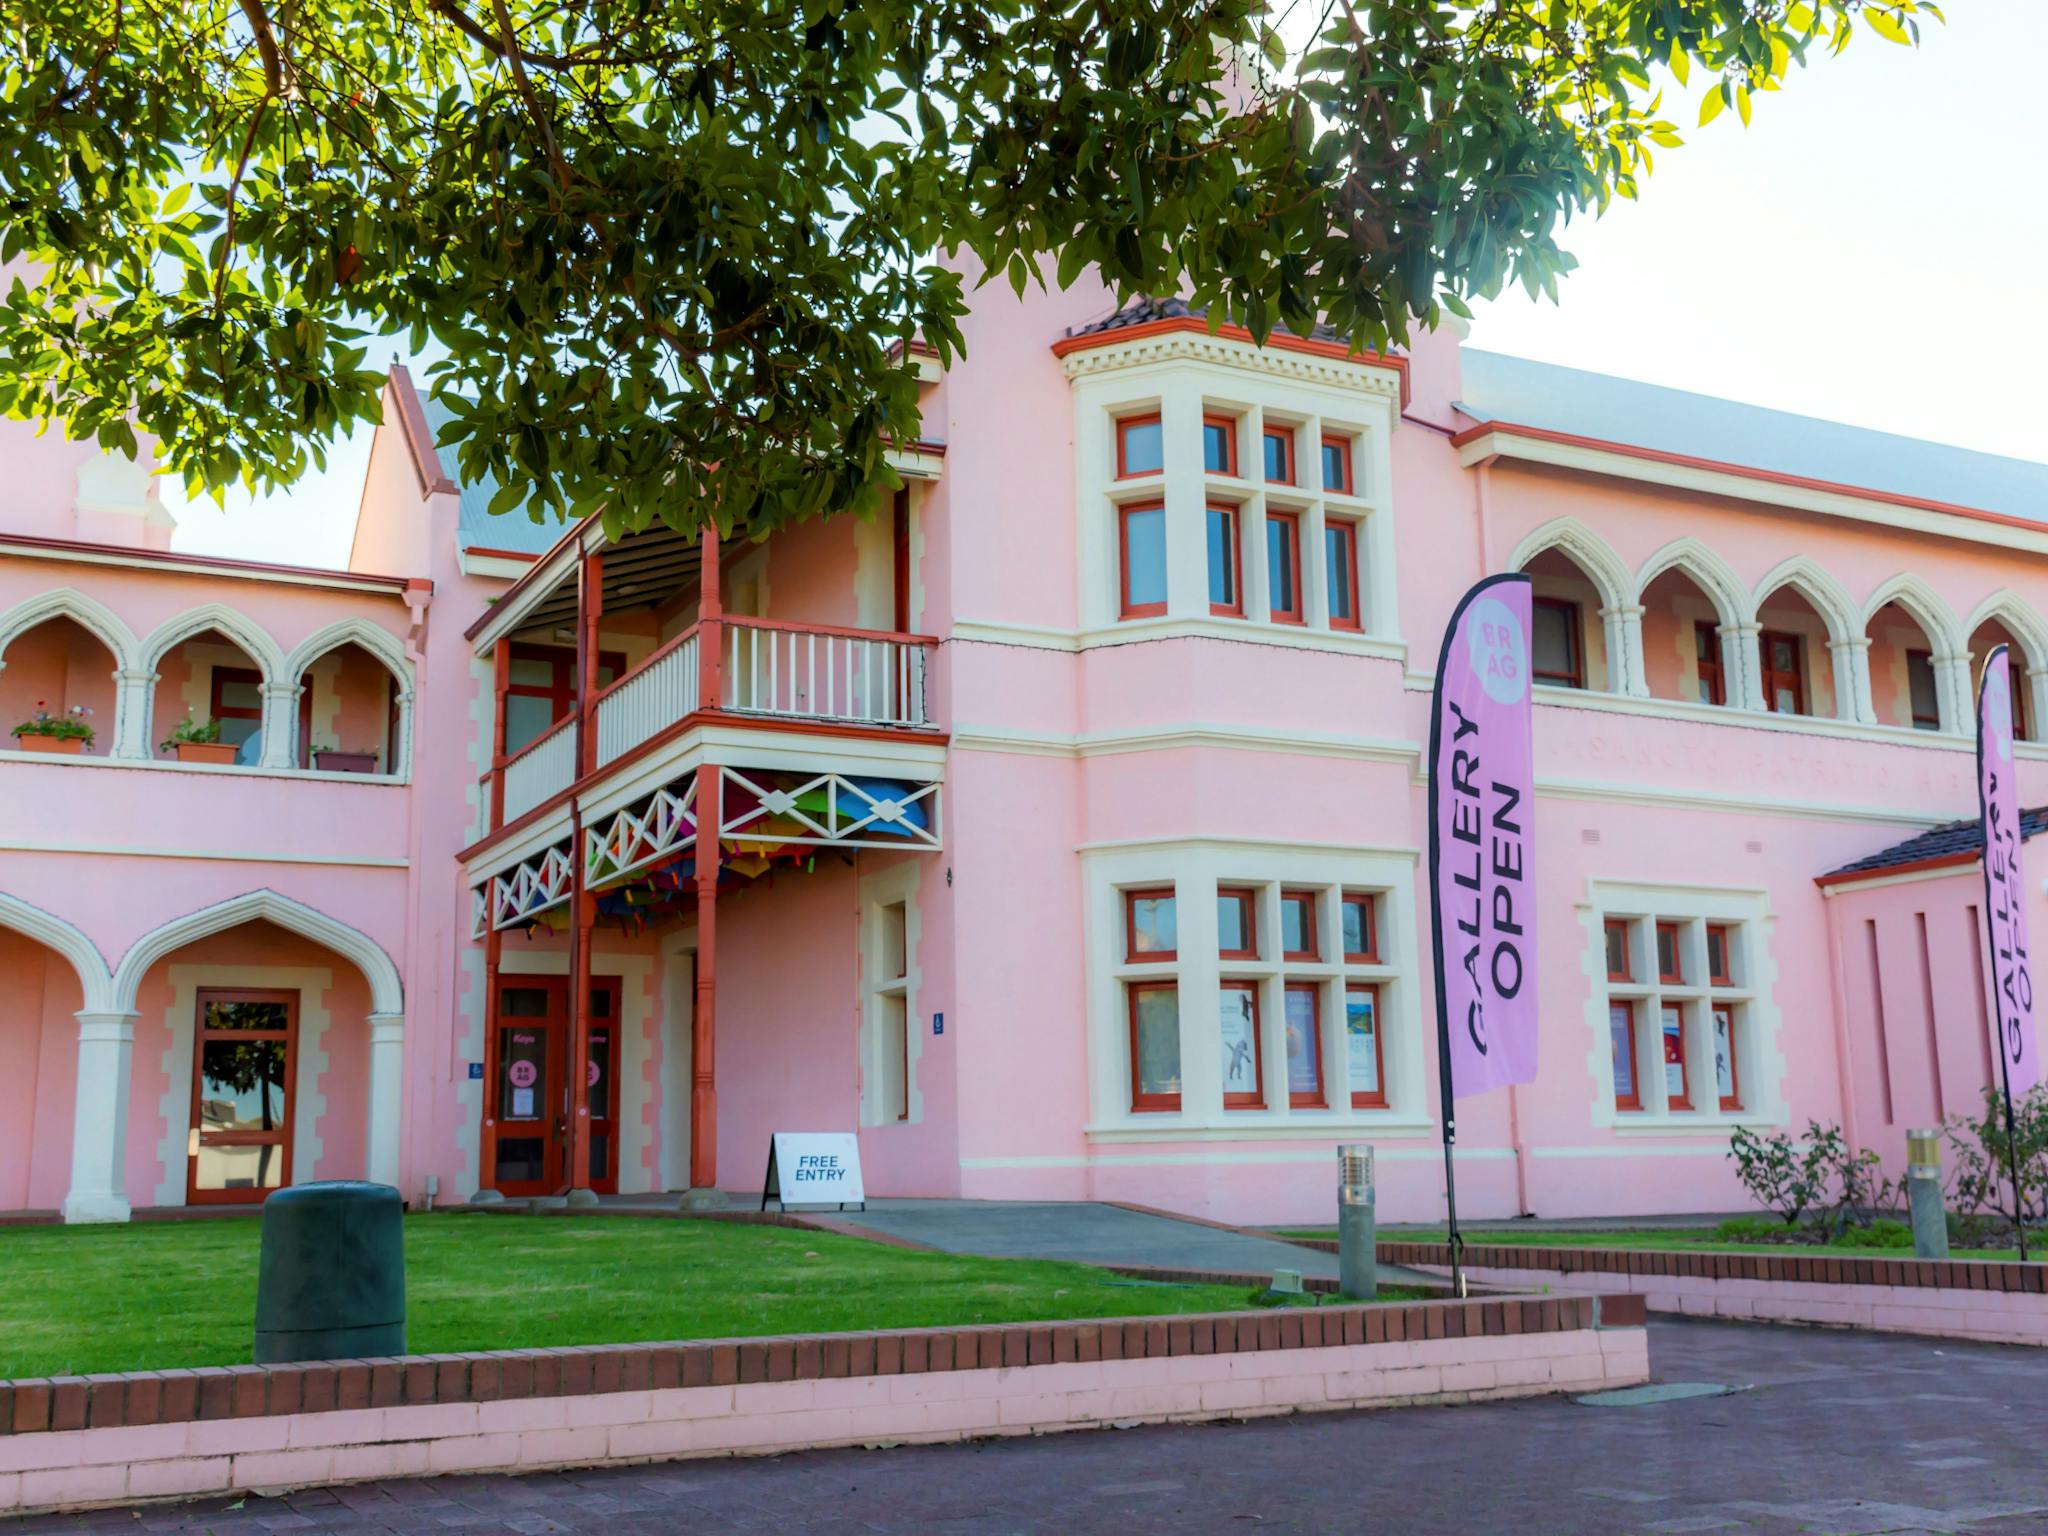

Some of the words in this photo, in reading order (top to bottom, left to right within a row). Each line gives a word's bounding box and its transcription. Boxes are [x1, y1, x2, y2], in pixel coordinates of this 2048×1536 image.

[1482, 622, 1514, 651] BR
[1486, 654, 1518, 679] AG
[1448, 700, 1488, 1057] GALLERY
[1491, 781, 1524, 1000] OPEN
[1989, 771, 2022, 1065] GALLERY
[795, 1169, 846, 1181] ENTRY
[799, 1155, 839, 1168] FREE
